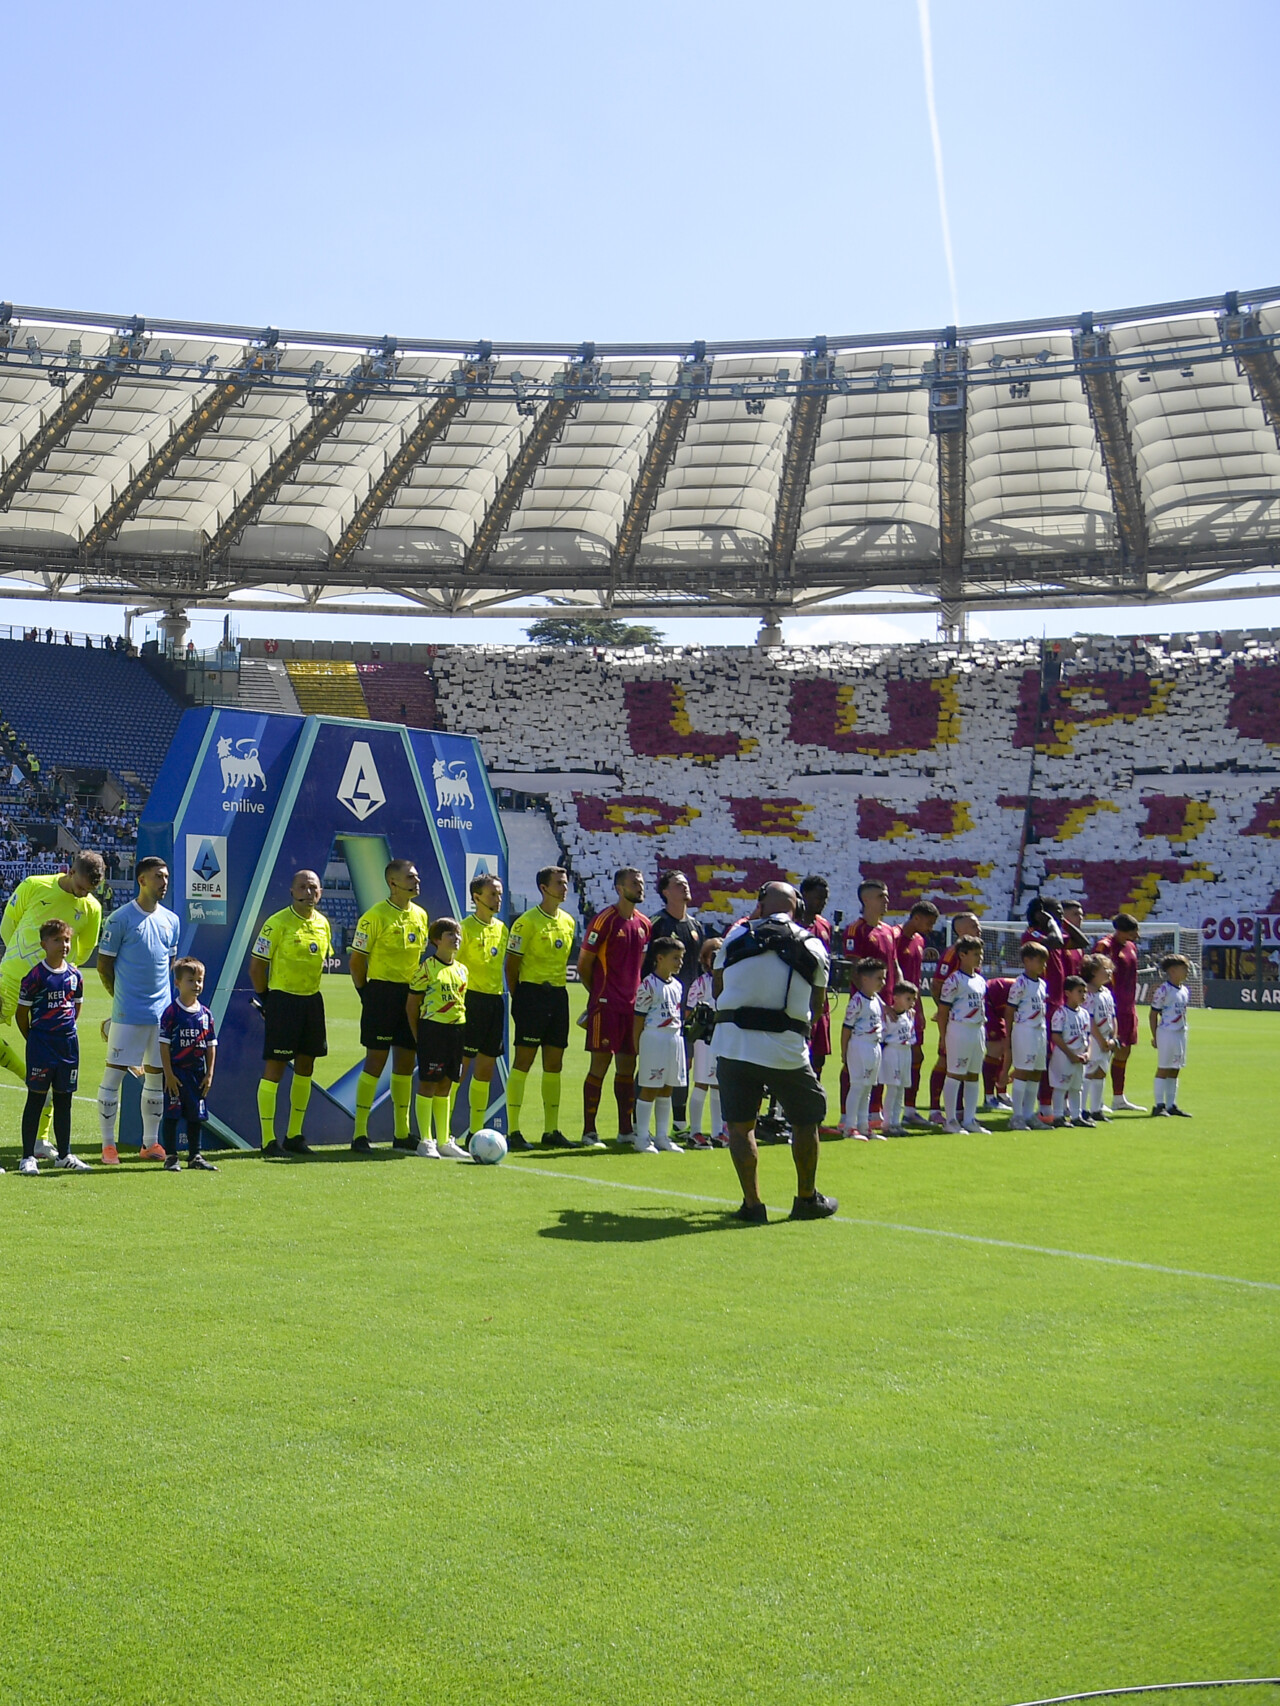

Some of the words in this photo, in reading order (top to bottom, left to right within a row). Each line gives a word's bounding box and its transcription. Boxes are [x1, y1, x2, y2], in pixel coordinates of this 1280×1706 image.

[222, 798, 265, 814] enilive
[436, 816, 473, 831] enilive
[192, 882, 214, 892] SERIE
[215, 884, 222, 893] A
[205, 909, 225, 917] enilive
[179, 1028, 200, 1038] KEEP
